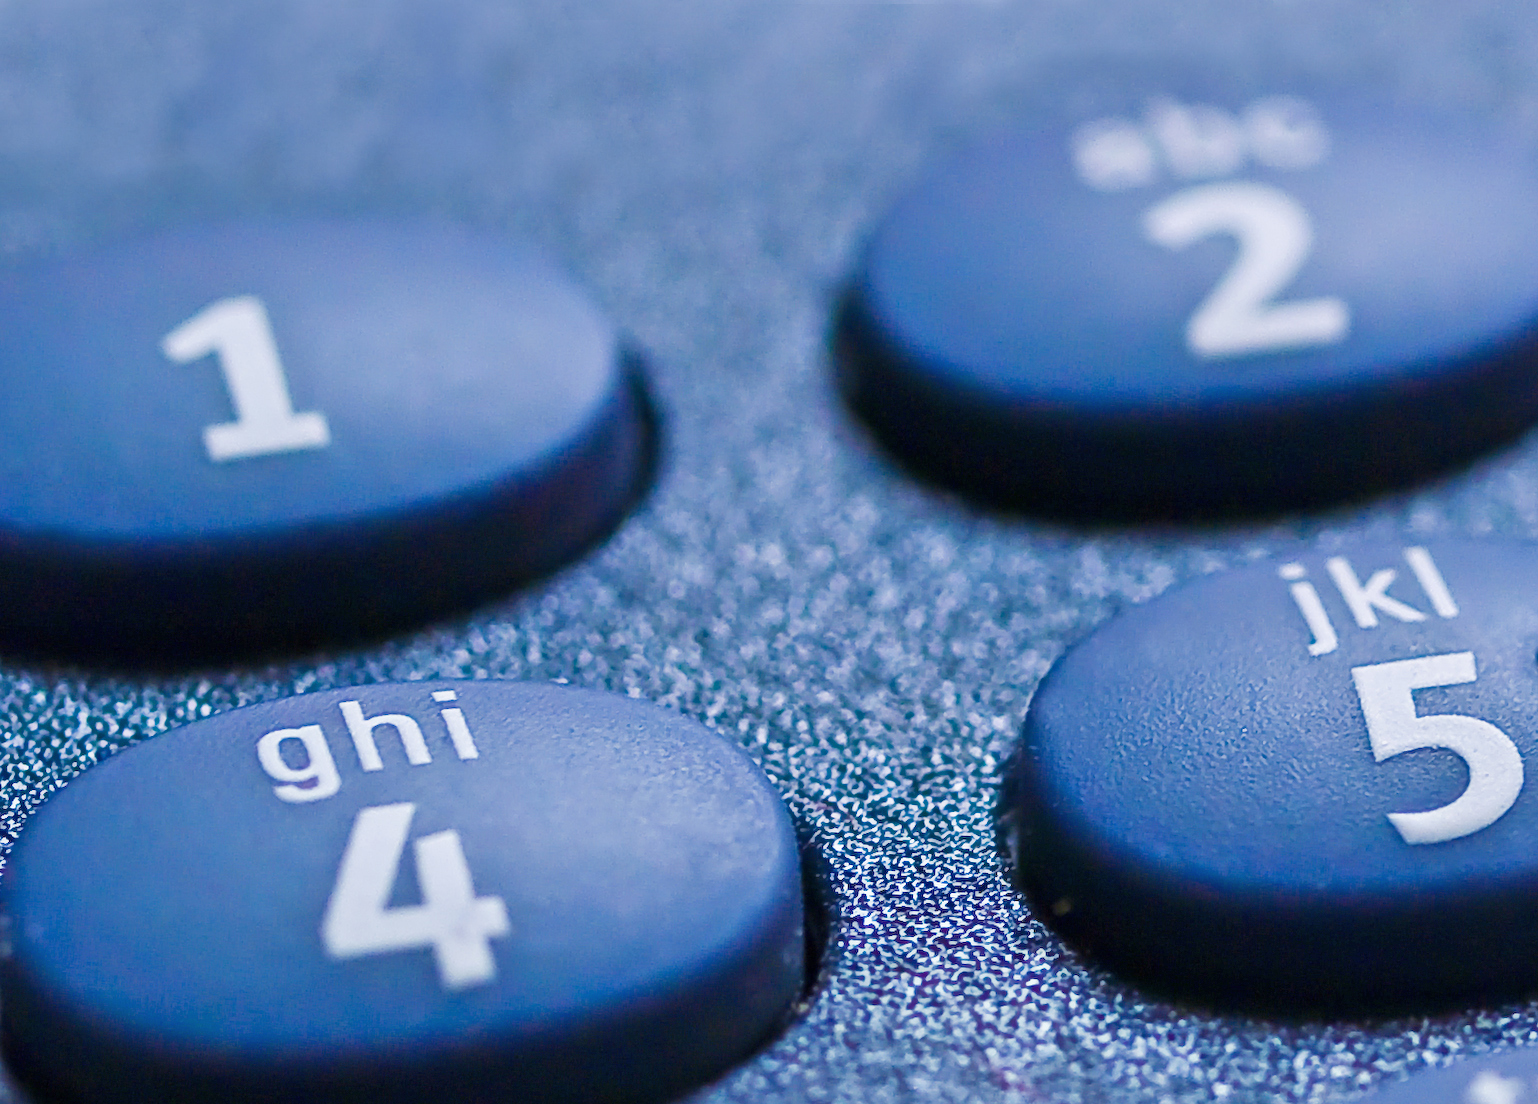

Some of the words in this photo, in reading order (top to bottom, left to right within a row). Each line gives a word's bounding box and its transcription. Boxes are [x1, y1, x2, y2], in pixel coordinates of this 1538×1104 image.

[1146, 186, 1350, 354] 2
[164, 297, 328, 458] 1
[1280, 548, 1458, 656] jkl
[257, 690, 478, 802] ghi
[1351, 652, 1524, 844] 5
[324, 802, 510, 984] 4
